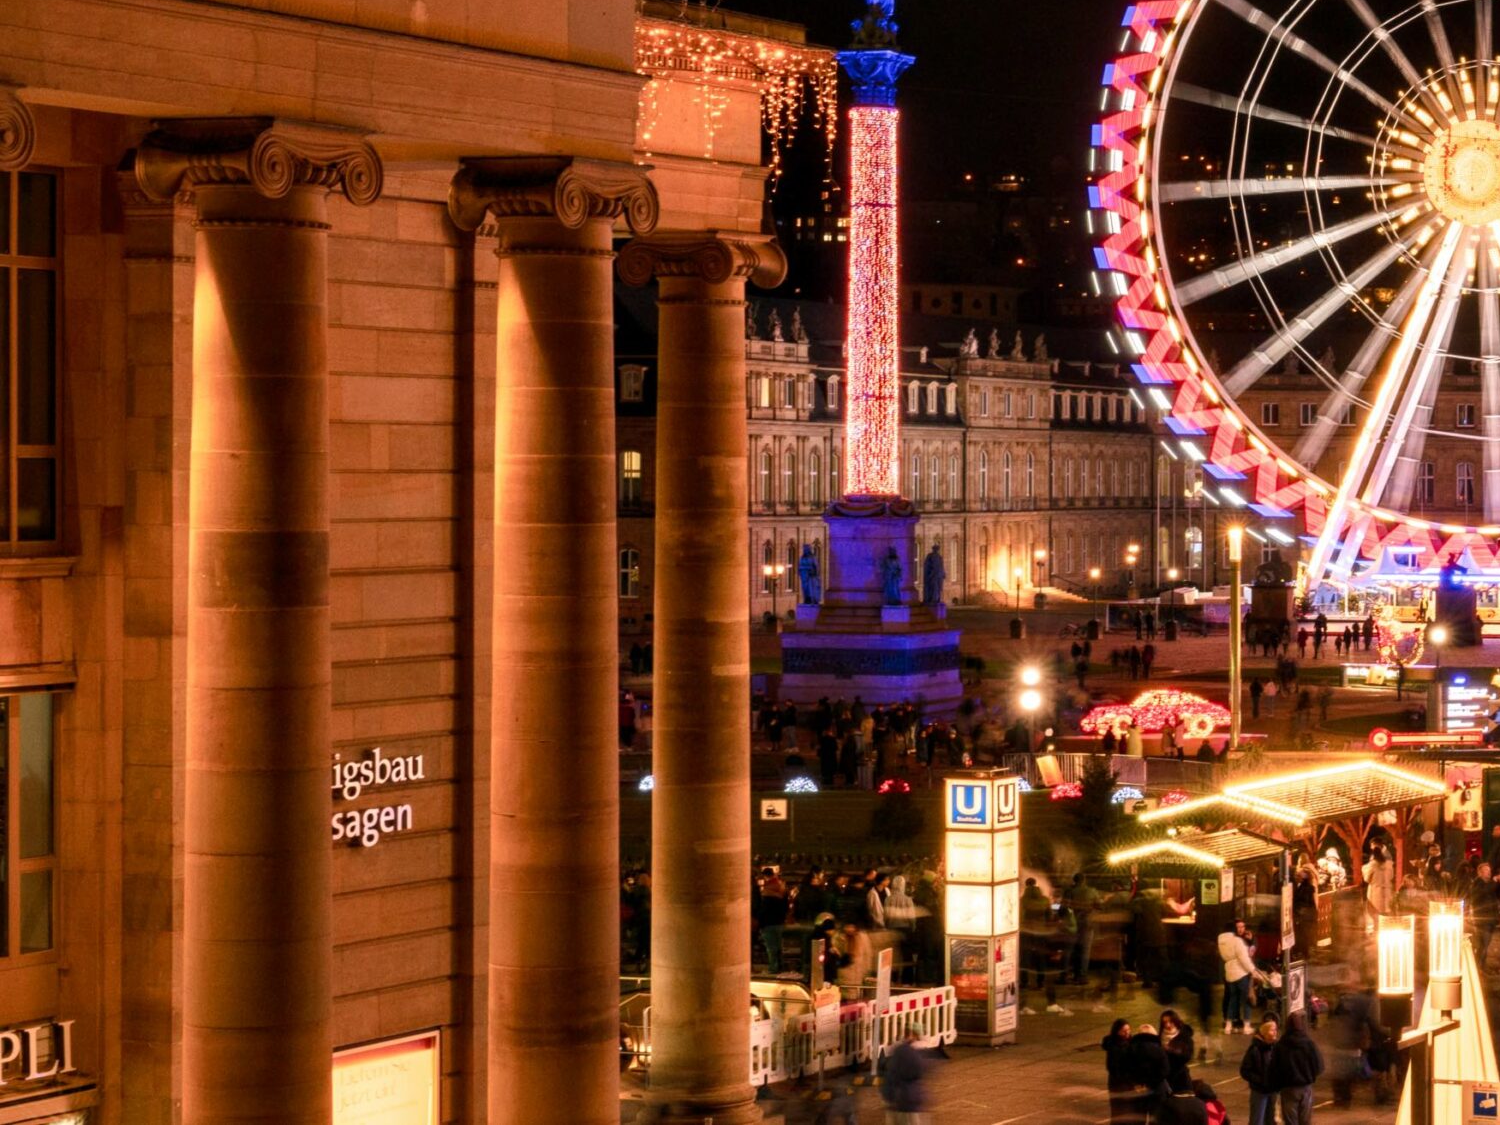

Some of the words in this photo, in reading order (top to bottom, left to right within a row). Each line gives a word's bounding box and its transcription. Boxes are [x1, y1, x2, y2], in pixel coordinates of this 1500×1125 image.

[956, 786, 982, 815] U
[999, 784, 1014, 815] U
[0, 1020, 77, 1086] PLI
